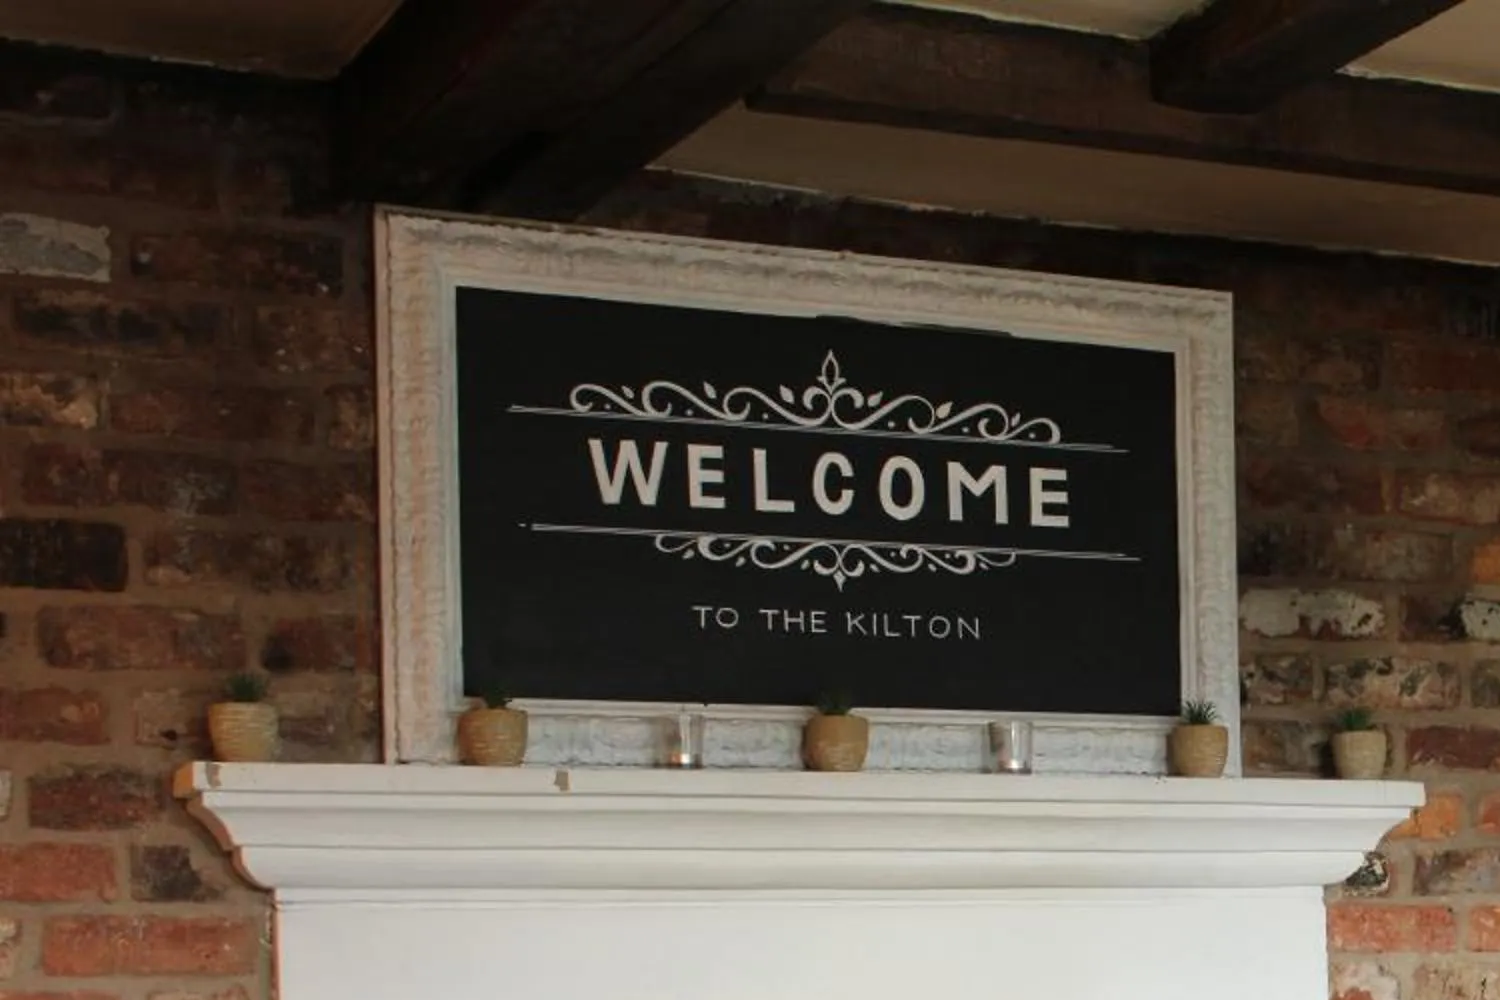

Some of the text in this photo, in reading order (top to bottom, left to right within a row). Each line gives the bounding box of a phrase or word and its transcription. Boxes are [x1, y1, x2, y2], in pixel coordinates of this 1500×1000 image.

[588, 437, 1070, 528] WELCOME
[692, 605, 981, 640] TO THE KILTON
